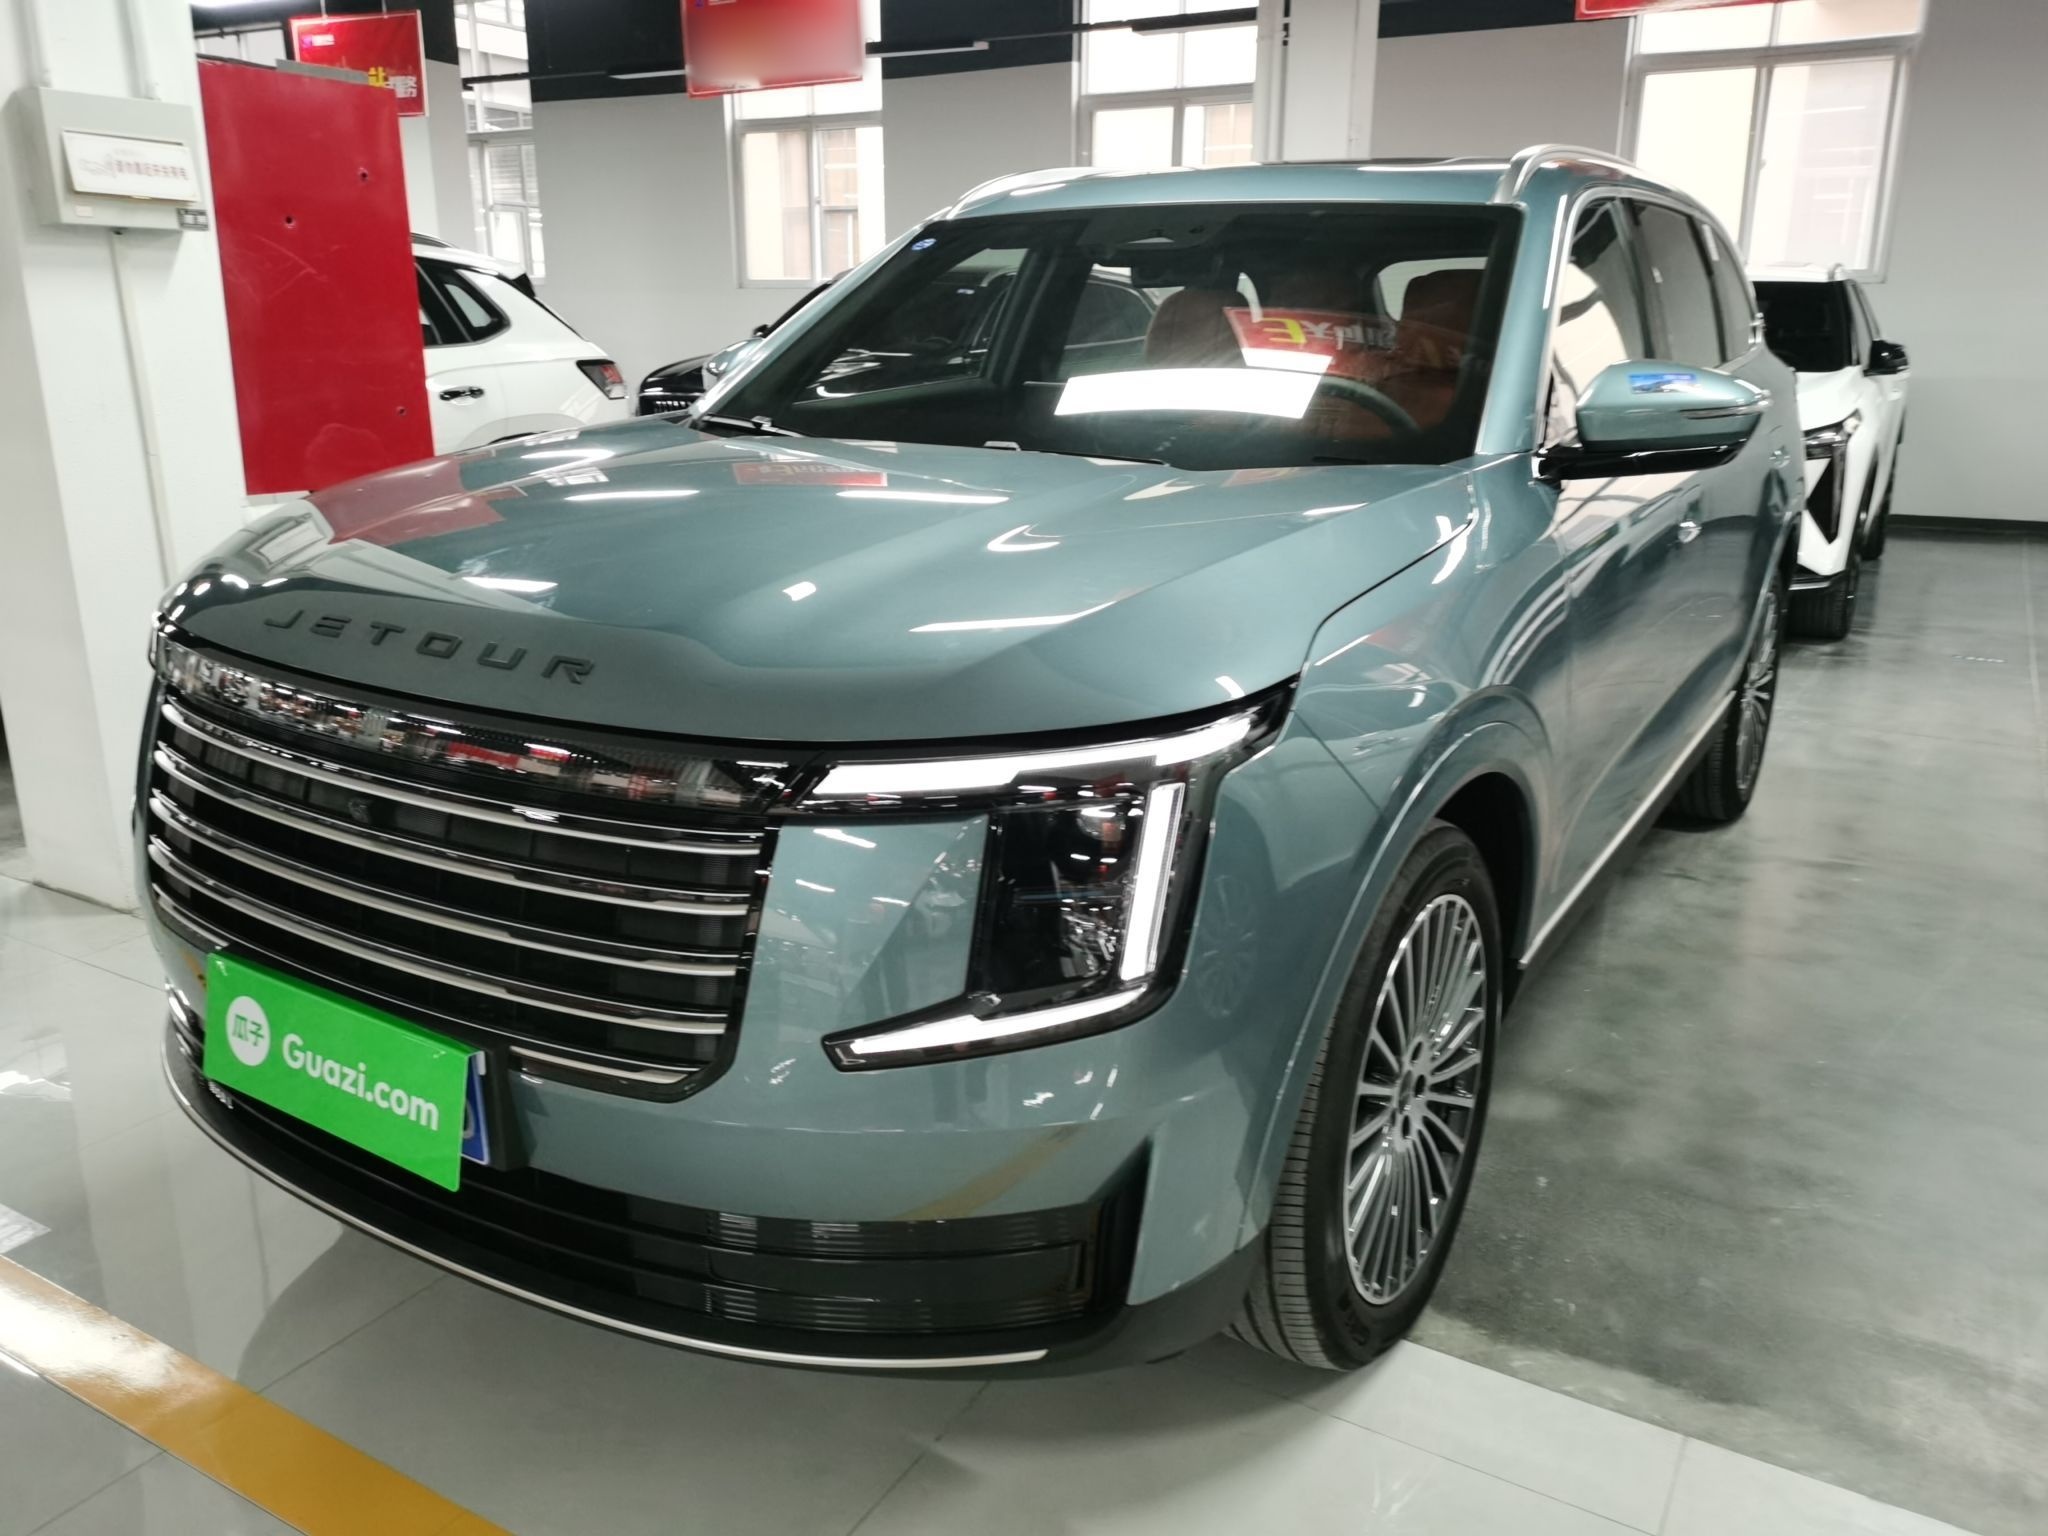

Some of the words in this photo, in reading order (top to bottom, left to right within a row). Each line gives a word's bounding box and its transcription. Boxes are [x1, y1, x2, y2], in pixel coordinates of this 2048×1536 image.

[263, 609, 595, 685] JETOUR
[231, 1013, 265, 1047] 瓜子
[282, 1033, 440, 1132] Guazi.com
